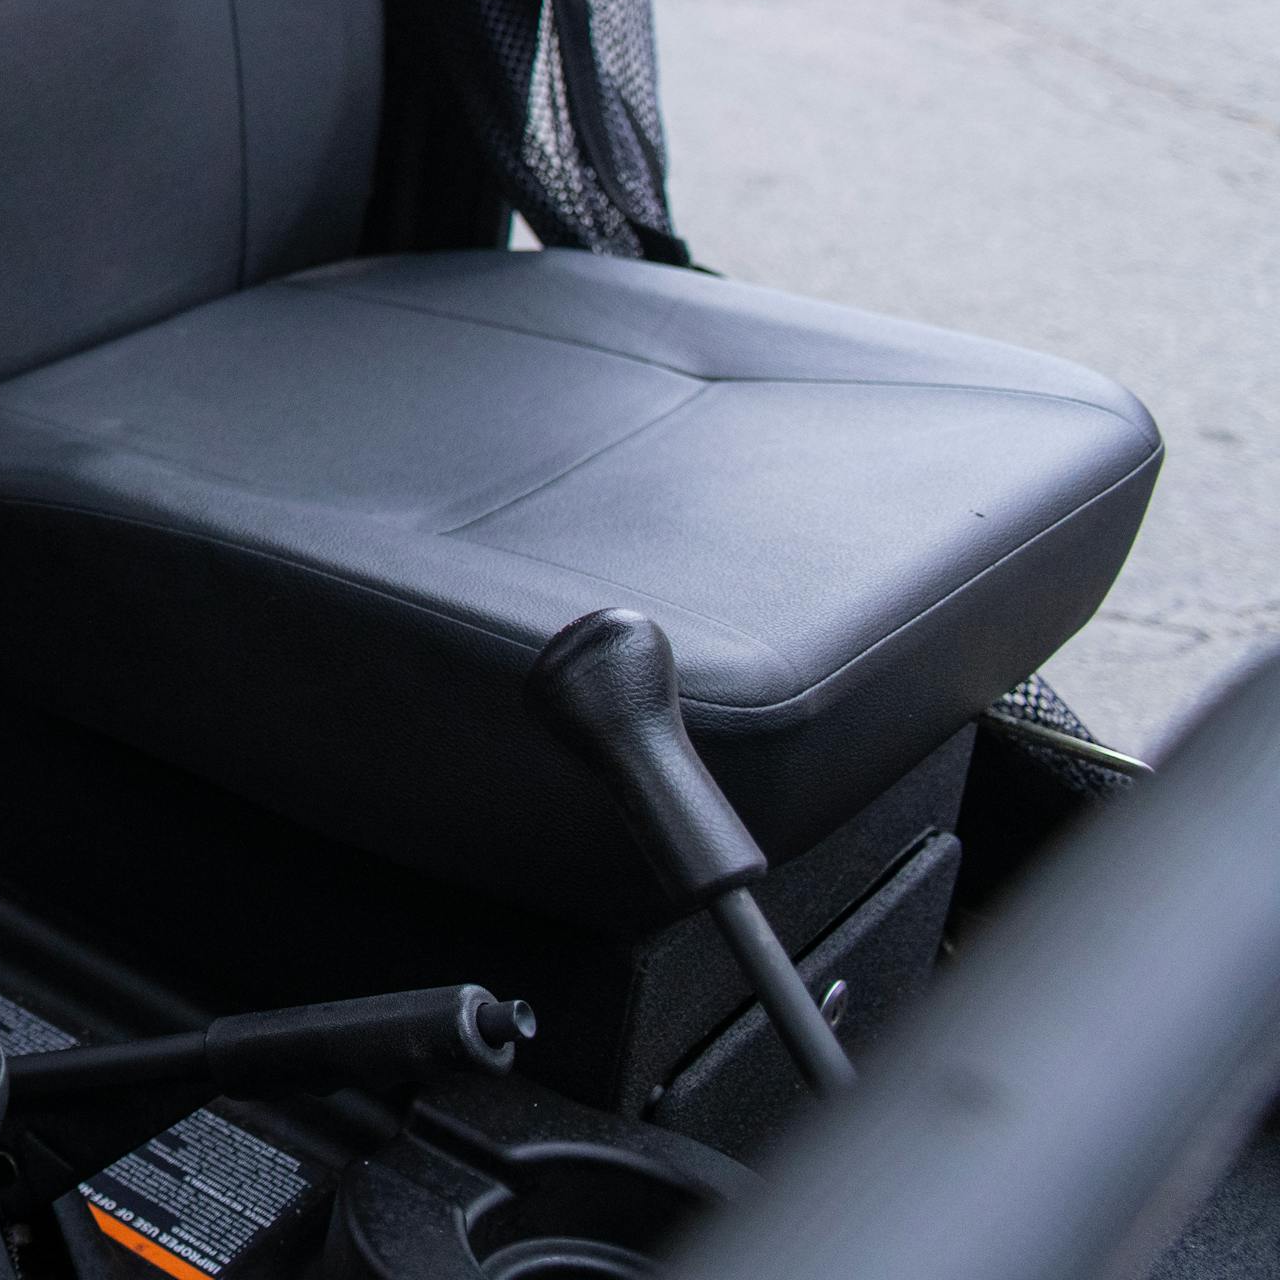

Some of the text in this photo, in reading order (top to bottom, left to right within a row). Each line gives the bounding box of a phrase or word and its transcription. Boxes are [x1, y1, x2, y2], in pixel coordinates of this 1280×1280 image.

[113, 1206, 135, 1222] OF
[131, 1216, 161, 1238] USE
[157, 1231, 222, 1275] IMPROPER
[170, 1225, 218, 1257] PREPARED
